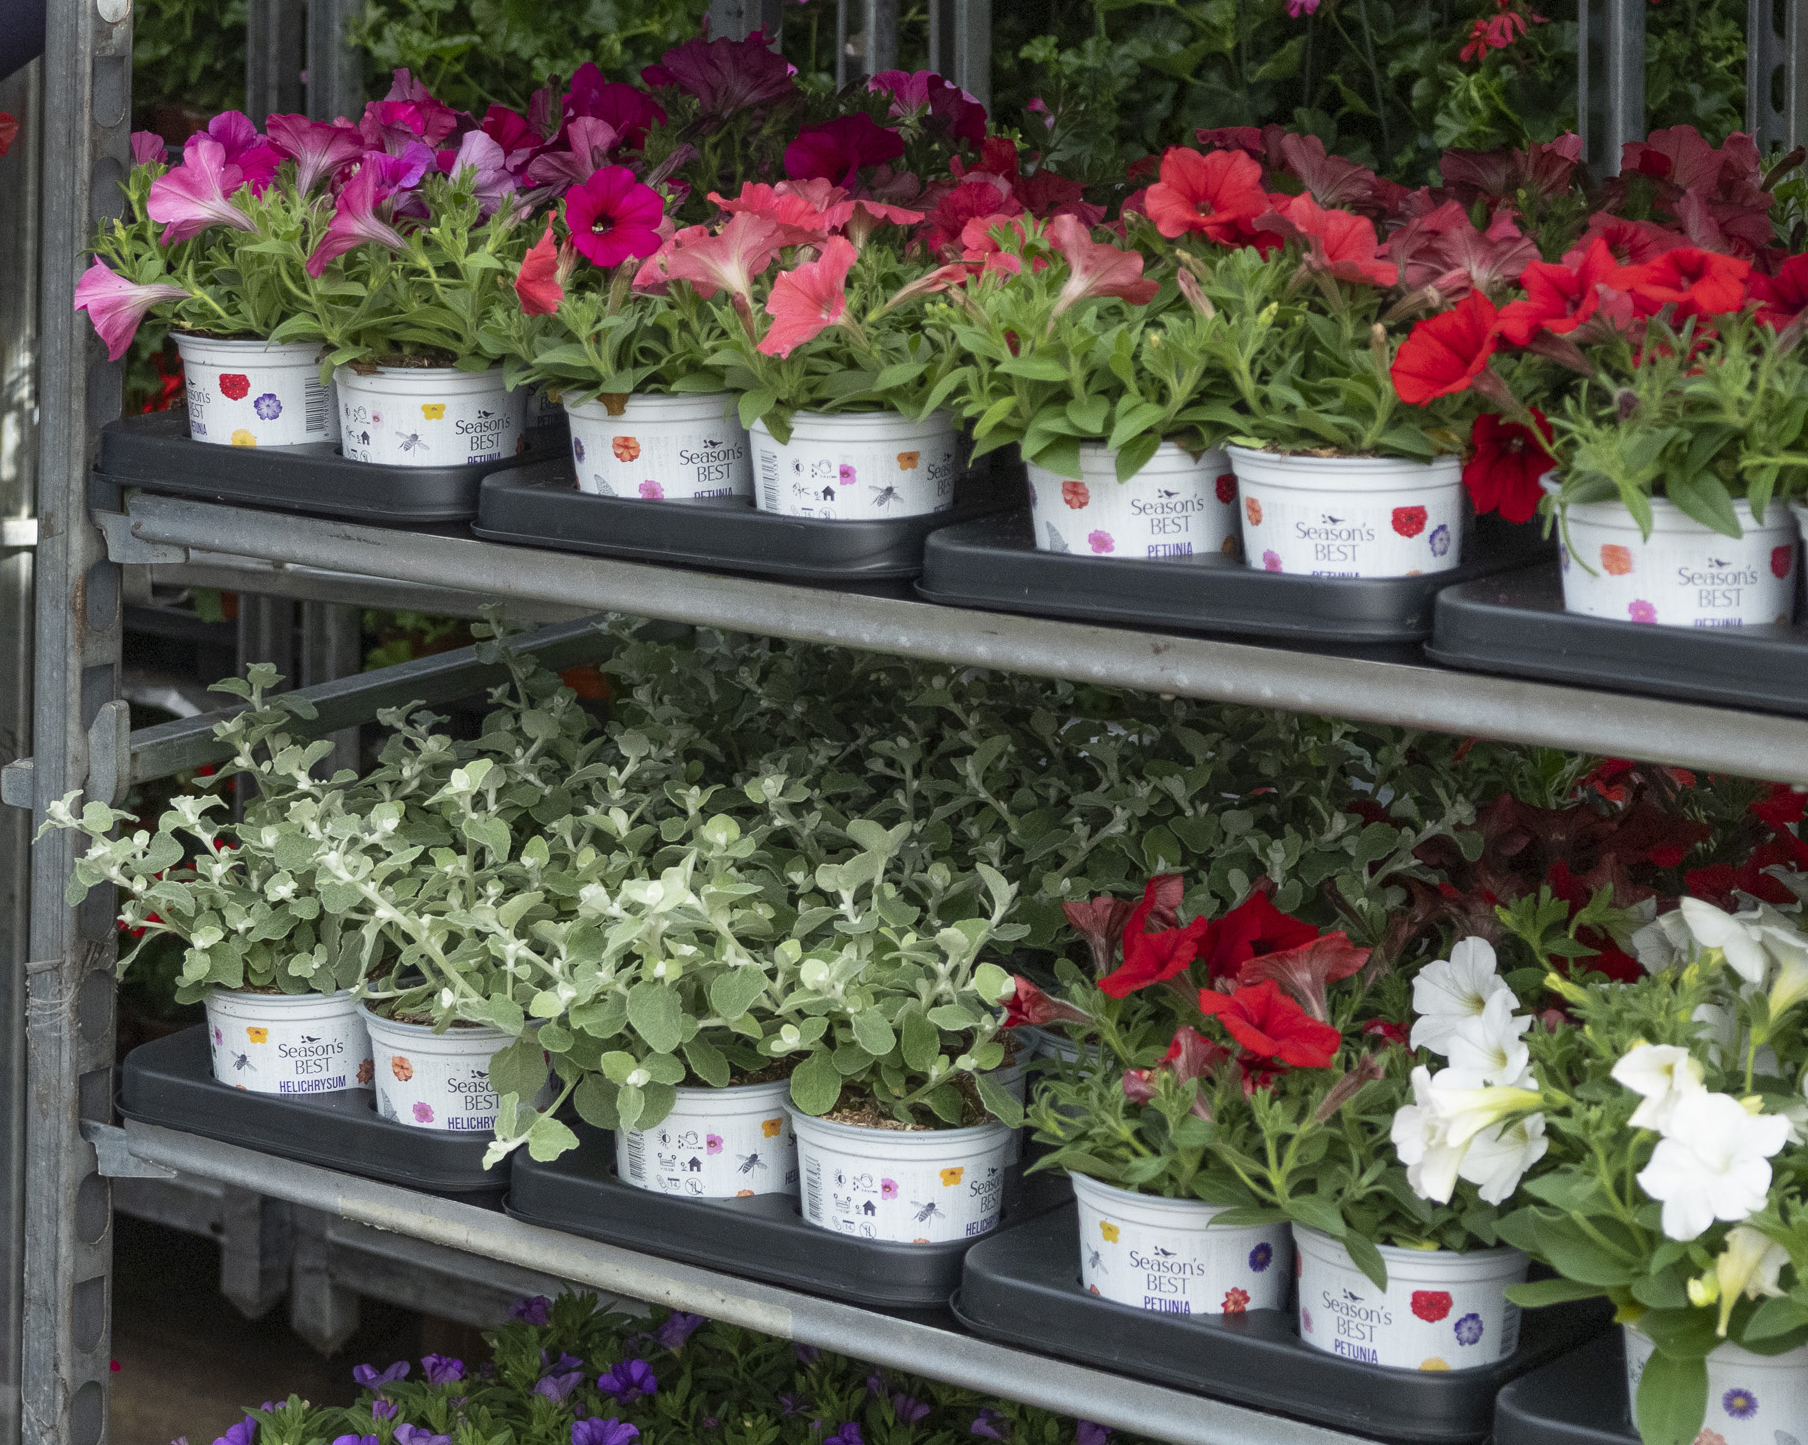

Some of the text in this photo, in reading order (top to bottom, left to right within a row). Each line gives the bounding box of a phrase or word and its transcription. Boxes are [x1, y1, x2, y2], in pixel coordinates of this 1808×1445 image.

[455, 414, 511, 432] Season's
[471, 432, 503, 451] BEST
[467, 452, 501, 464] PETUNIA
[680, 448, 743, 466] Season's
[697, 463, 732, 482] BEST
[1130, 498, 1204, 515] Season's
[1150, 515, 1191, 535] BEST
[1295, 525, 1375, 542] Season's
[1148, 542, 1193, 557] PETUNIA
[1315, 543, 1359, 562] BEST
[1678, 565, 1758, 586] Season's
[1699, 589, 1743, 608] BEST
[278, 1039, 344, 1059] Season's
[295, 1057, 330, 1075] BEST
[279, 1075, 346, 1093] HELICHRYSUM
[447, 1077, 492, 1094] Seaso
[447, 1115, 498, 1130] HELICHRY
[1129, 1249, 1205, 1276] Season's
[1146, 1275, 1190, 1295] BEST
[1143, 1296, 1192, 1315] PETUNIA
[1323, 1290, 1392, 1324] Season's
[1336, 1317, 1377, 1342] BEST
[1334, 1338, 1378, 1364] PETUNIA
